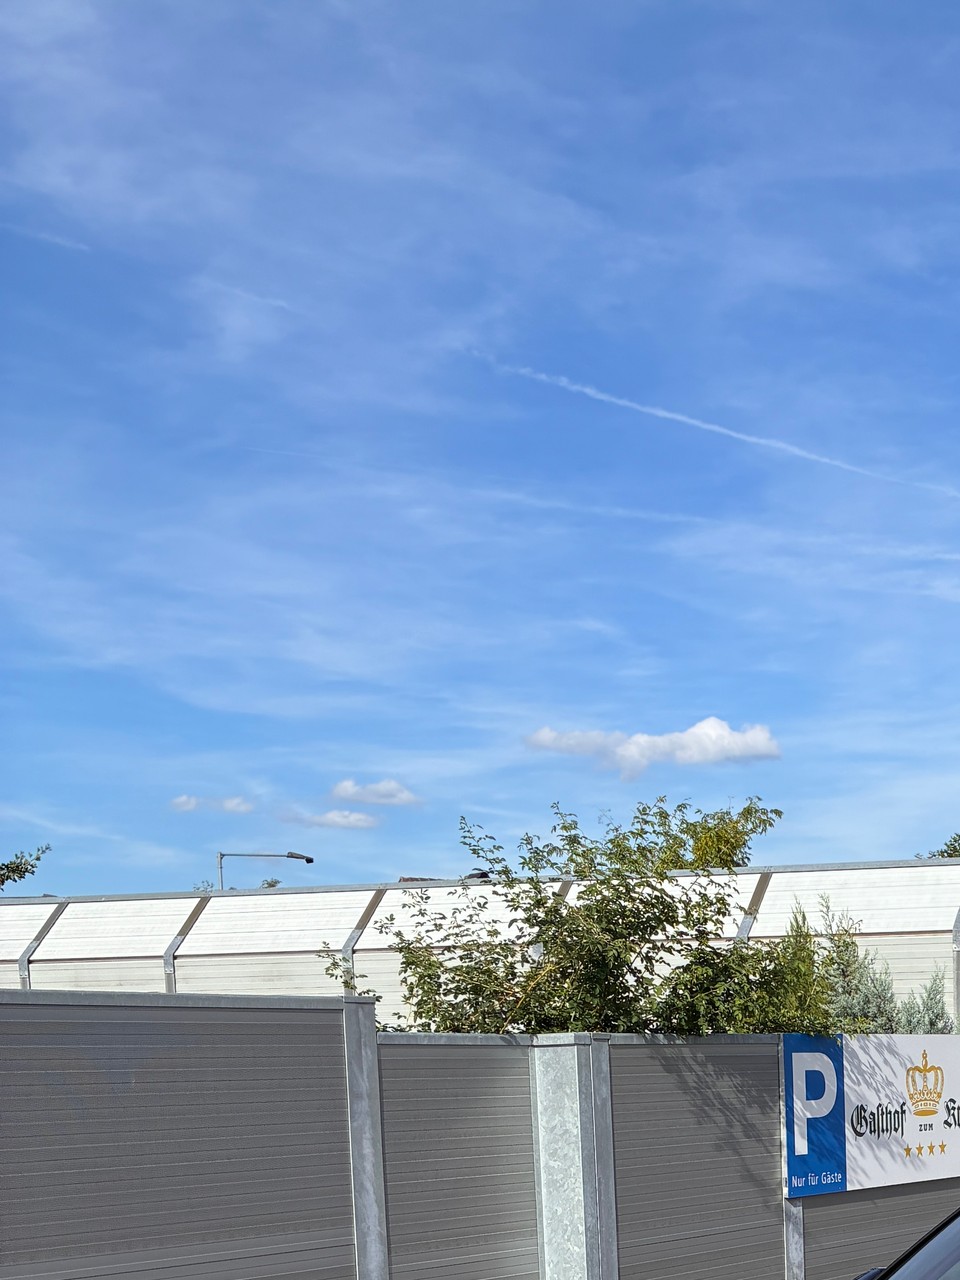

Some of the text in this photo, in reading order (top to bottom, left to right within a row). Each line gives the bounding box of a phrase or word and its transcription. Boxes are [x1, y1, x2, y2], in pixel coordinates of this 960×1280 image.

[791, 1052, 838, 1156] P
[918, 1123, 934, 1132] ZUM
[791, 1171, 842, 1188] Nur für Gäste
